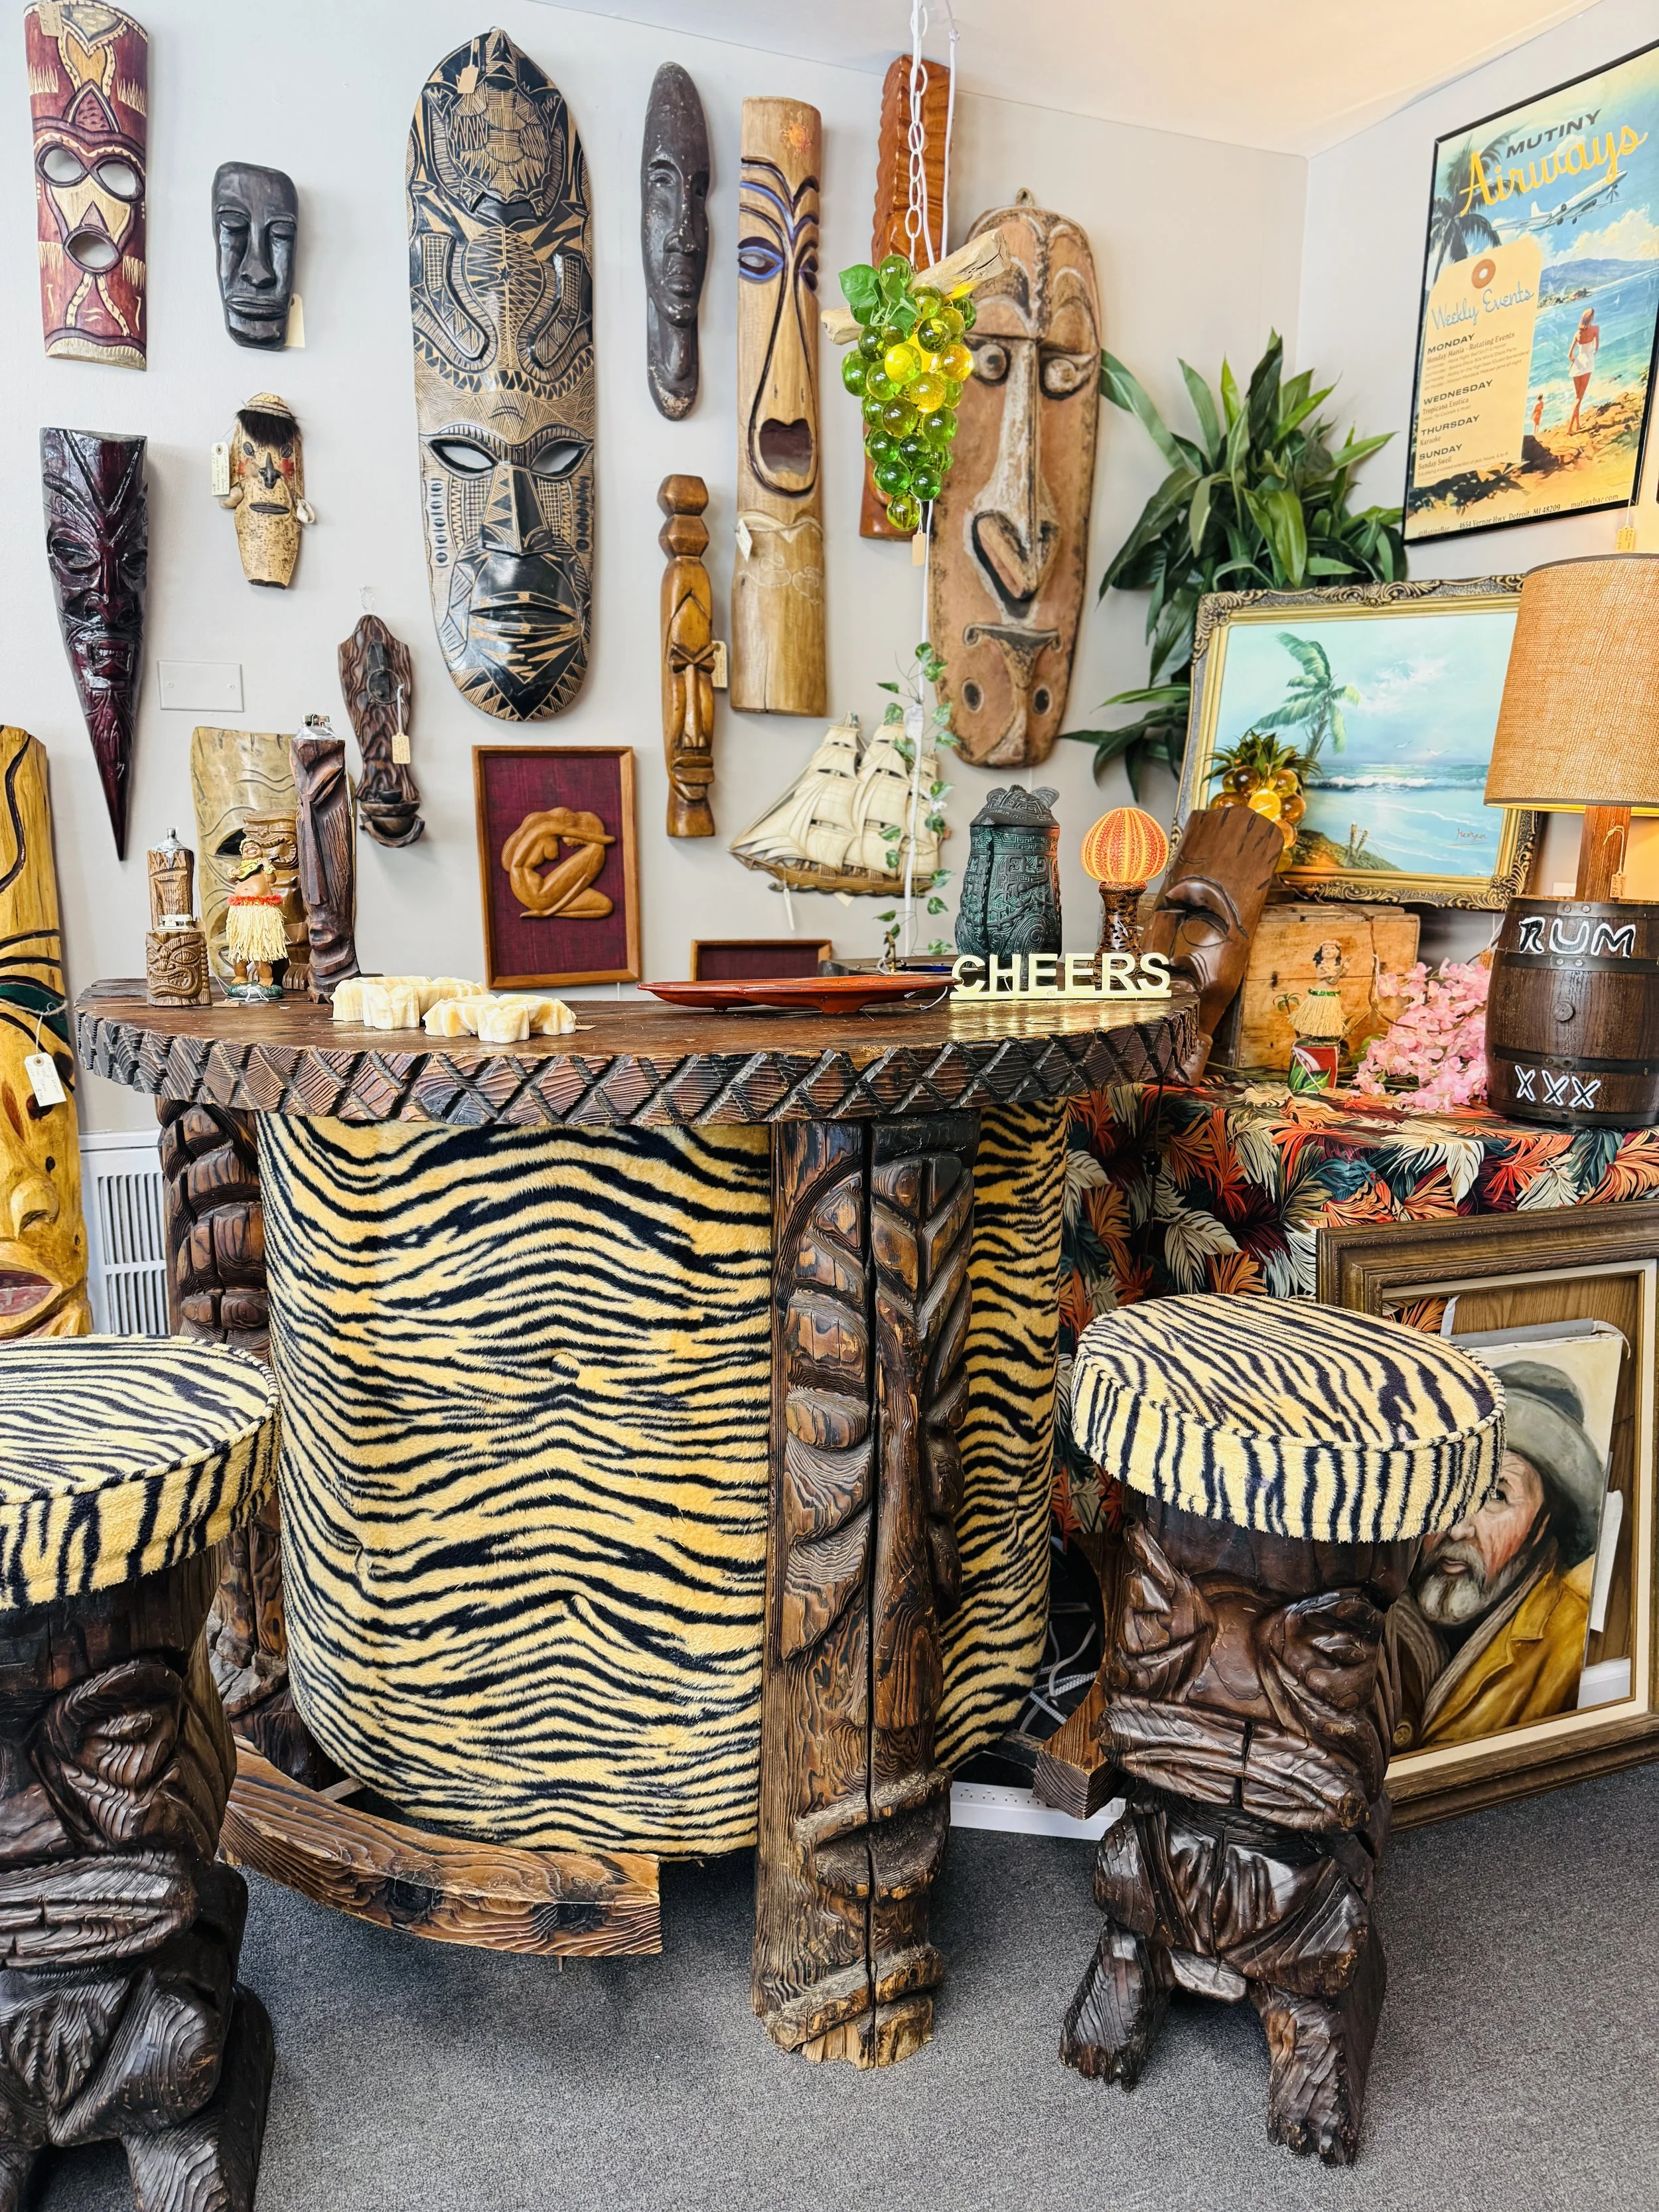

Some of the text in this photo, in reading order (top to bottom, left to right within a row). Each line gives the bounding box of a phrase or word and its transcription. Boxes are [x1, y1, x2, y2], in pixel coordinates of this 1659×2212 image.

[1506, 109, 1601, 159] MUTINY
[1460, 125, 1648, 217] Airways
[1431, 281, 1534, 329] Weekly Events
[1427, 334, 1475, 354] MONDAY
[1427, 352, 1446, 364] Monday
[1447, 348, 1464, 359] Mania
[1469, 338, 1493, 351] Rotating
[1495, 332, 1515, 342] Events
[1423, 379, 1493, 406] WEDNESDAY
[1423, 398, 1469, 415] Tropicana Exotica
[1420, 436, 1441, 446] Karaoke
[1421, 415, 1480, 436] THURSDAY
[1418, 456, 1452, 470] Sunday Swell
[1419, 444, 1463, 461] SUNDAY
[1459, 521, 1471, 530] 4654
[1473, 517, 1492, 526] Vernor
[1509, 510, 1532, 520] Detroit,
[1542, 504, 1561, 514] 48209
[1571, 494, 1619, 508] mutinybar.com
[1519, 917, 1636, 958] RUM
[951, 952, 1171, 993] CHEERS
[1514, 1065, 1601, 1109] XXX
